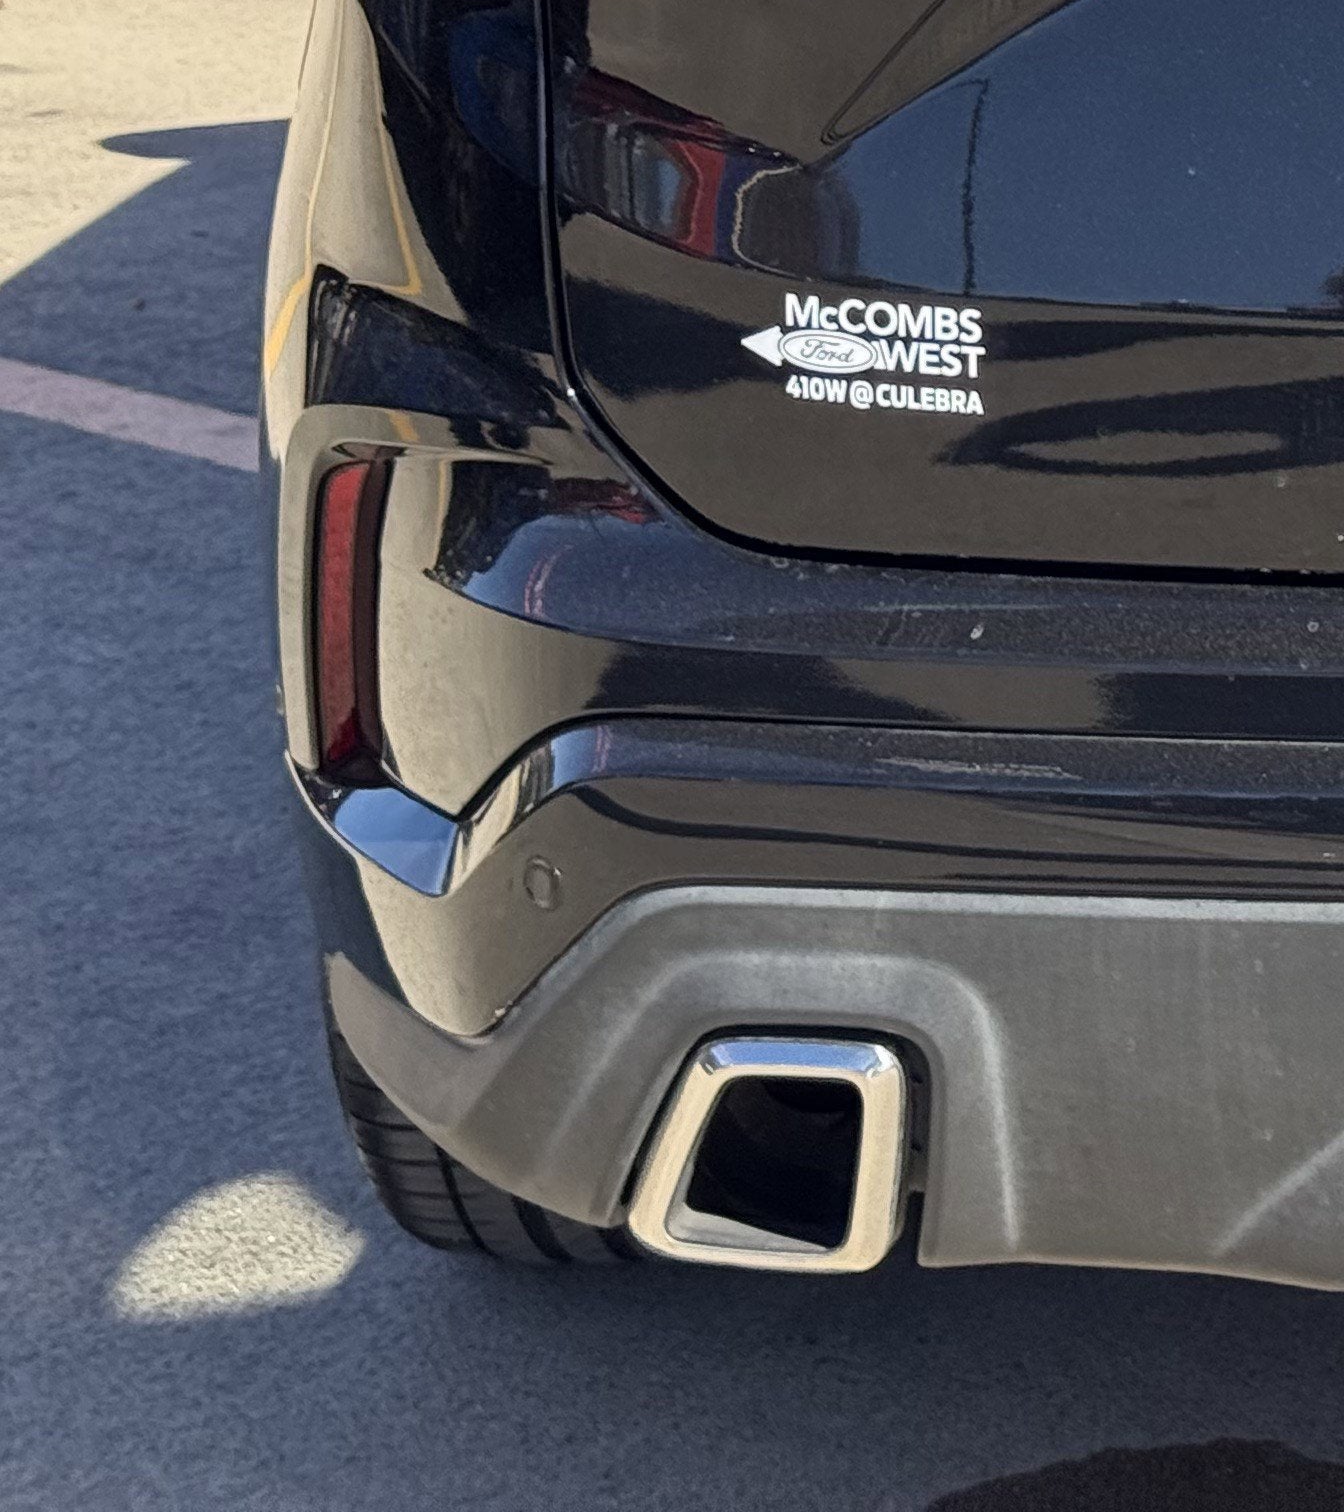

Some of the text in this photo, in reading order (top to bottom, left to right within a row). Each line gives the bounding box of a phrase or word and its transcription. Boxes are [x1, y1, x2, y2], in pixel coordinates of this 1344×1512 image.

[785, 291, 984, 344] McCOMBS
[799, 338, 986, 379] Ford WEST
